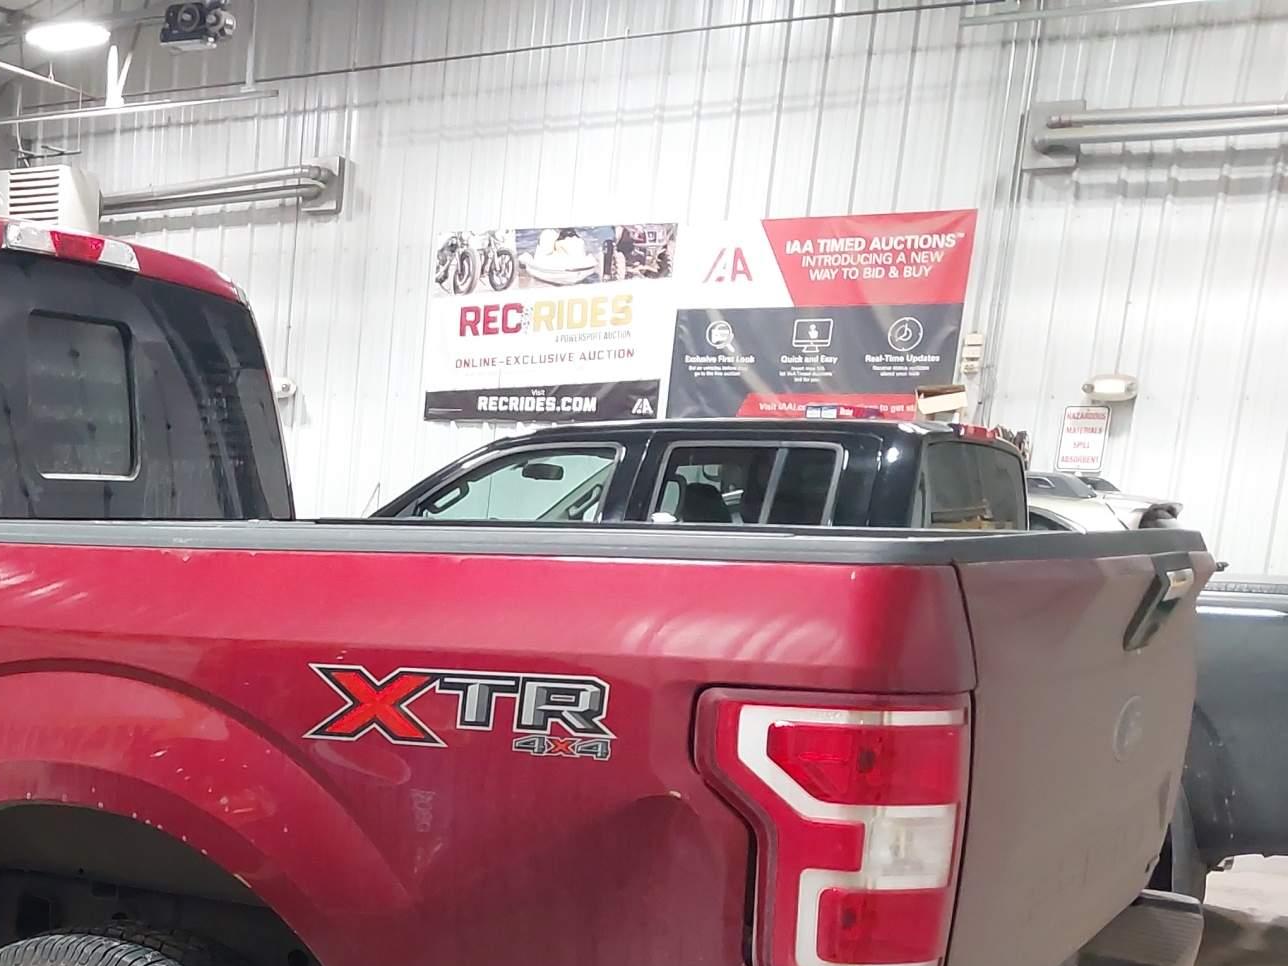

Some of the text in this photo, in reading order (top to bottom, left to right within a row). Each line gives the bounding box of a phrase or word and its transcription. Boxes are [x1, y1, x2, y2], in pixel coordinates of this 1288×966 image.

[786, 239, 812, 254] IAA
[818, 236, 866, 252] TIMED
[801, 250, 944, 267] INTRODUCING A NEW
[809, 264, 932, 281] WAY TO BID & BUY
[455, 348, 636, 369] ONLINE-EXCLUSIVE AUCTION
[780, 355, 839, 365] Quick and Easy
[477, 396, 597, 412] RECRIDES.COM
[759, 402, 777, 411] Visit
[879, 404, 889, 412] to
[890, 404, 905, 414] get
[302, 663, 617, 748] XTR
